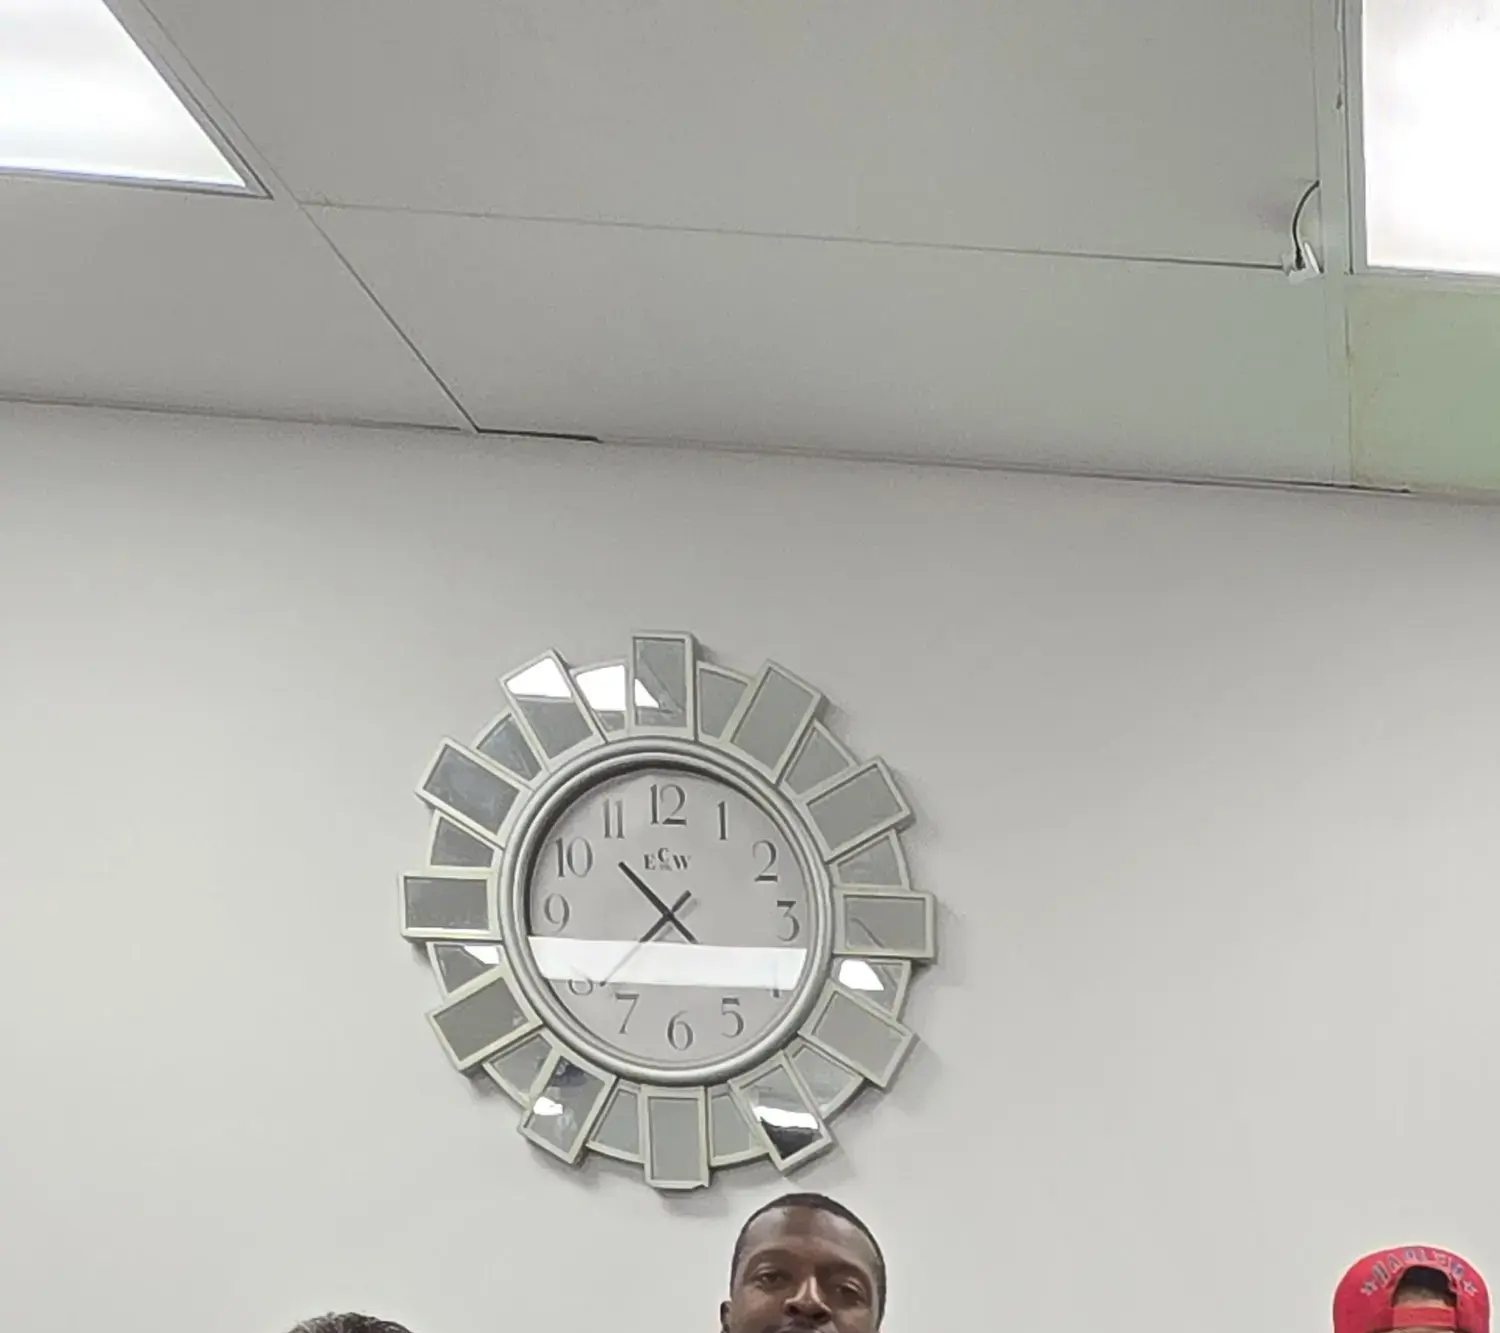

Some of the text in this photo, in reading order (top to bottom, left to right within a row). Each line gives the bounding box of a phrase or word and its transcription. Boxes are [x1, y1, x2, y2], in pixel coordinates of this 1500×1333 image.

[602, 798, 626, 839] 11
[649, 783, 688, 826] 12
[717, 800, 728, 841] 1
[555, 836, 594, 879] 10
[751, 839, 779, 883] 2
[543, 893, 571, 933] 9
[775, 899, 801, 942] 3
[614, 992, 640, 1035] 7
[666, 1010, 694, 1051] 6
[720, 996, 745, 1039] 5
